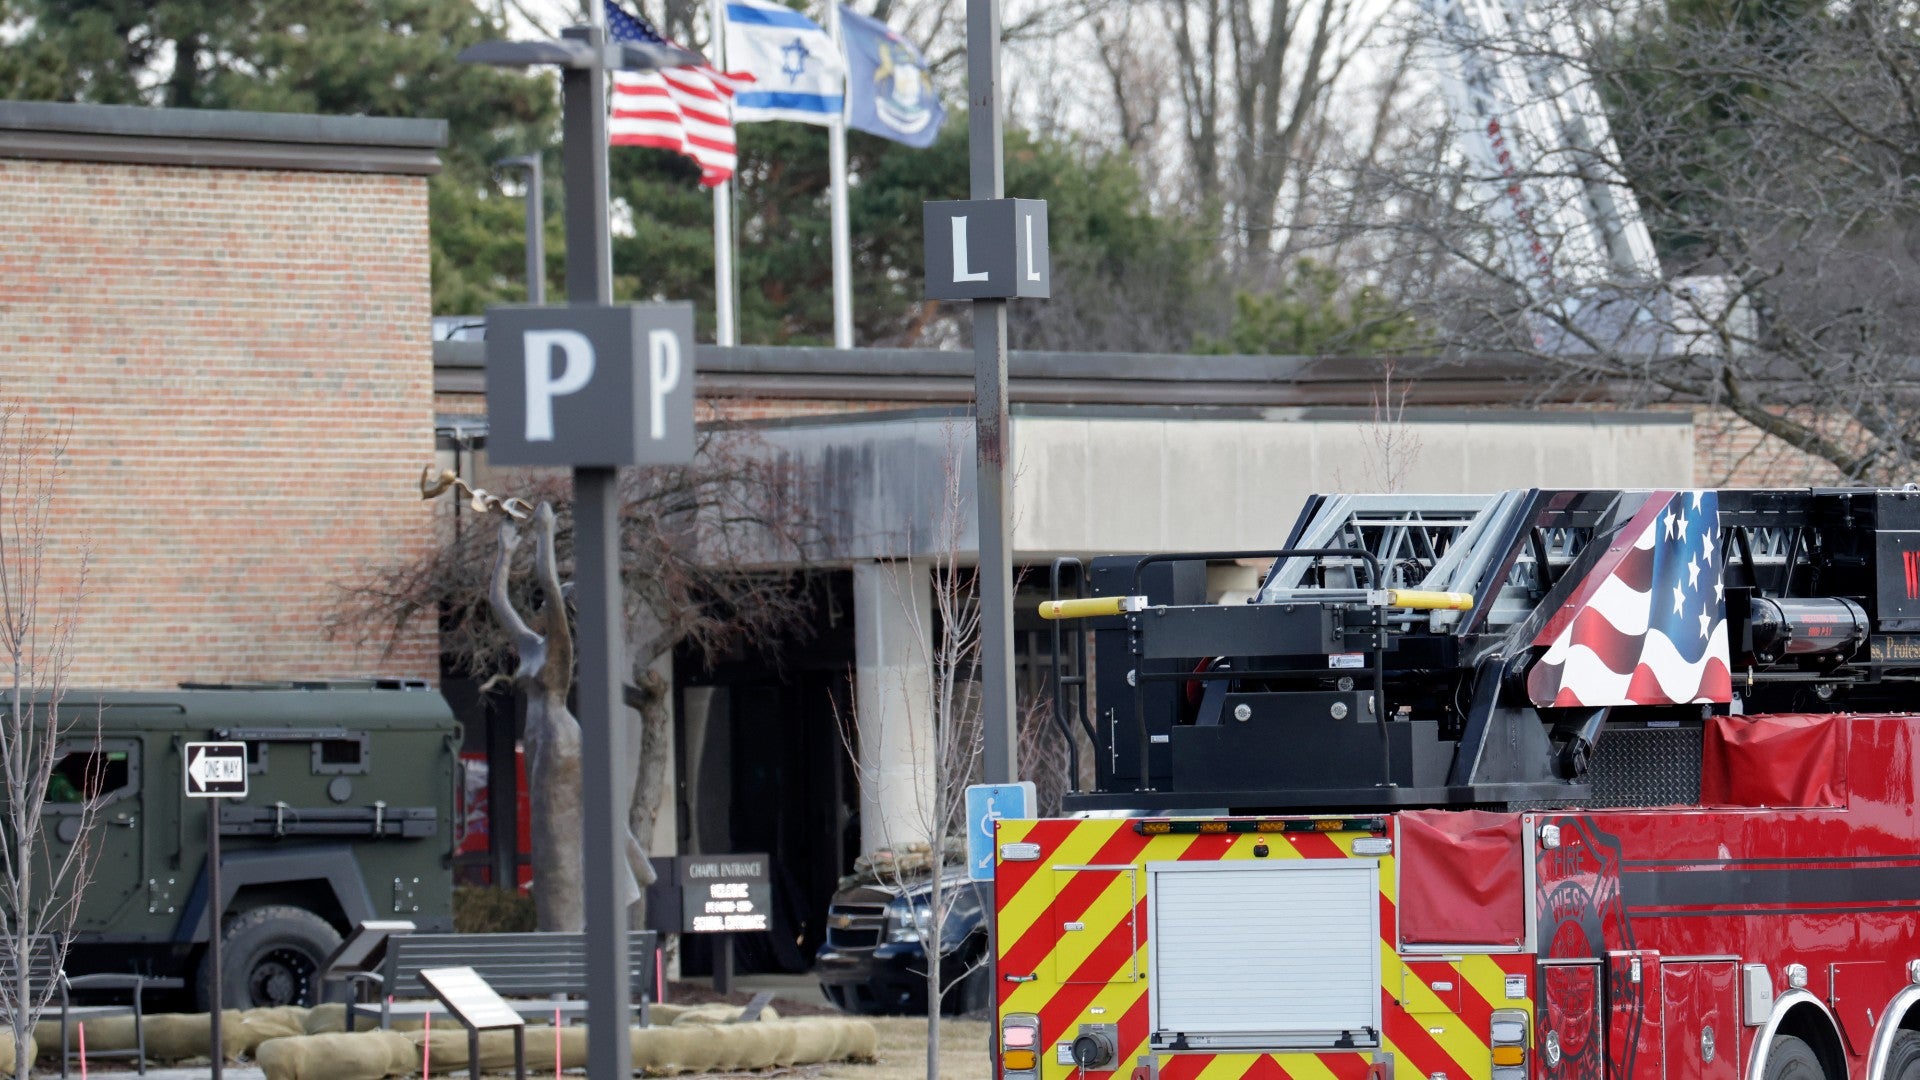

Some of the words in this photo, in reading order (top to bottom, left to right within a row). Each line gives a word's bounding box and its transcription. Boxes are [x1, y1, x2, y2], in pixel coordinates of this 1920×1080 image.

[950, 215, 989, 283] L
[1025, 214, 1041, 282] L
[523, 328, 597, 441] P
[648, 328, 681, 440] P
[204, 760, 220, 778] ONE
[221, 760, 240, 778] WAY
[690, 864, 719, 878] CHAPEL
[721, 862, 760, 877] ENTRANCE
[1553, 845, 1585, 876] FIRE
[1550, 888, 1589, 924] WEST
